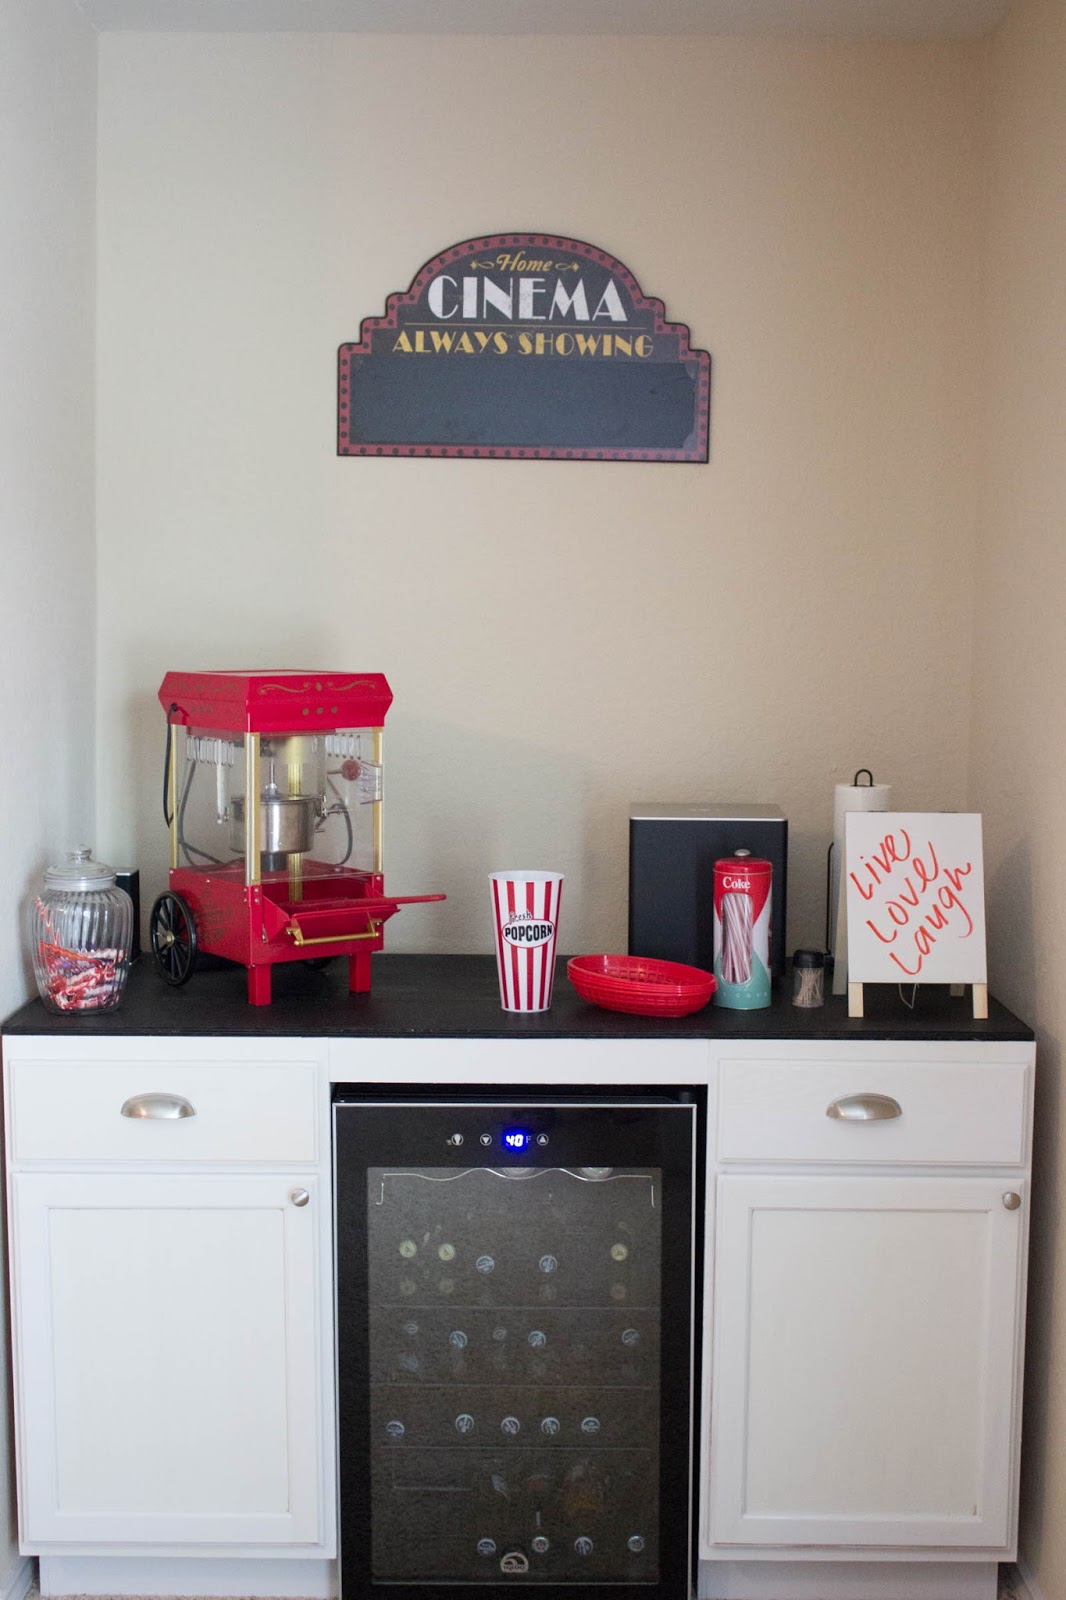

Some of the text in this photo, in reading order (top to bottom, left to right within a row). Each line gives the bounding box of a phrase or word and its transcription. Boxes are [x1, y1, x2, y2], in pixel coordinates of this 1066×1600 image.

[496, 250, 553, 272] Home
[428, 275, 628, 322] CINEMA
[392, 330, 654, 358] ALWAYS SHOWING
[849, 828, 911, 900] Live
[722, 876, 751, 890] Coke
[865, 841, 939, 944] Love
[889, 862, 974, 975] Laugh
[504, 924, 553, 942] POPCORN
[505, 1133, 524, 1147] 40
